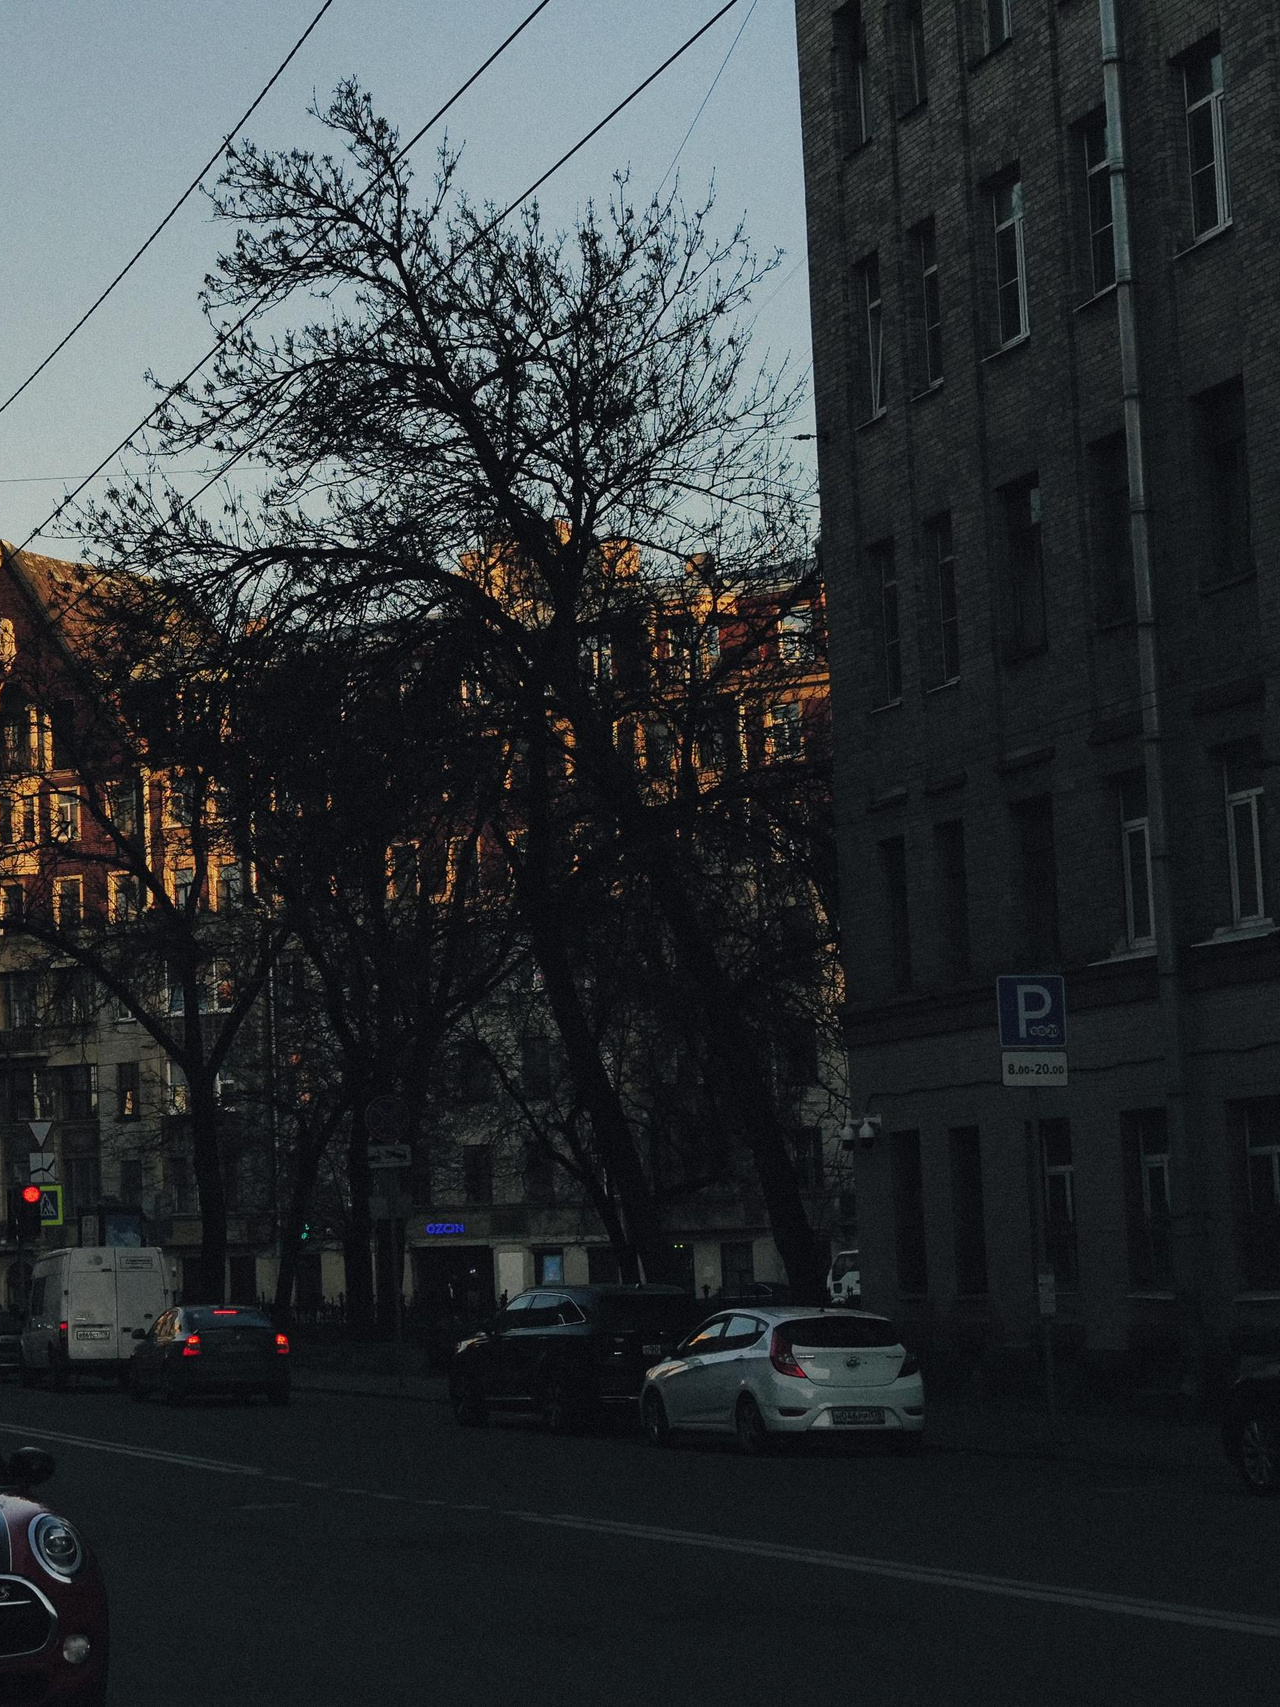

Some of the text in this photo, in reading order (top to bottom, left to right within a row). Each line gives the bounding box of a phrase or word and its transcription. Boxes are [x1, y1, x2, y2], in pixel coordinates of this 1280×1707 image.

[1017, 985, 1052, 1038] P
[1008, 1063, 1064, 1075] 8.00-20.00
[426, 1223, 465, 1235] OZON
